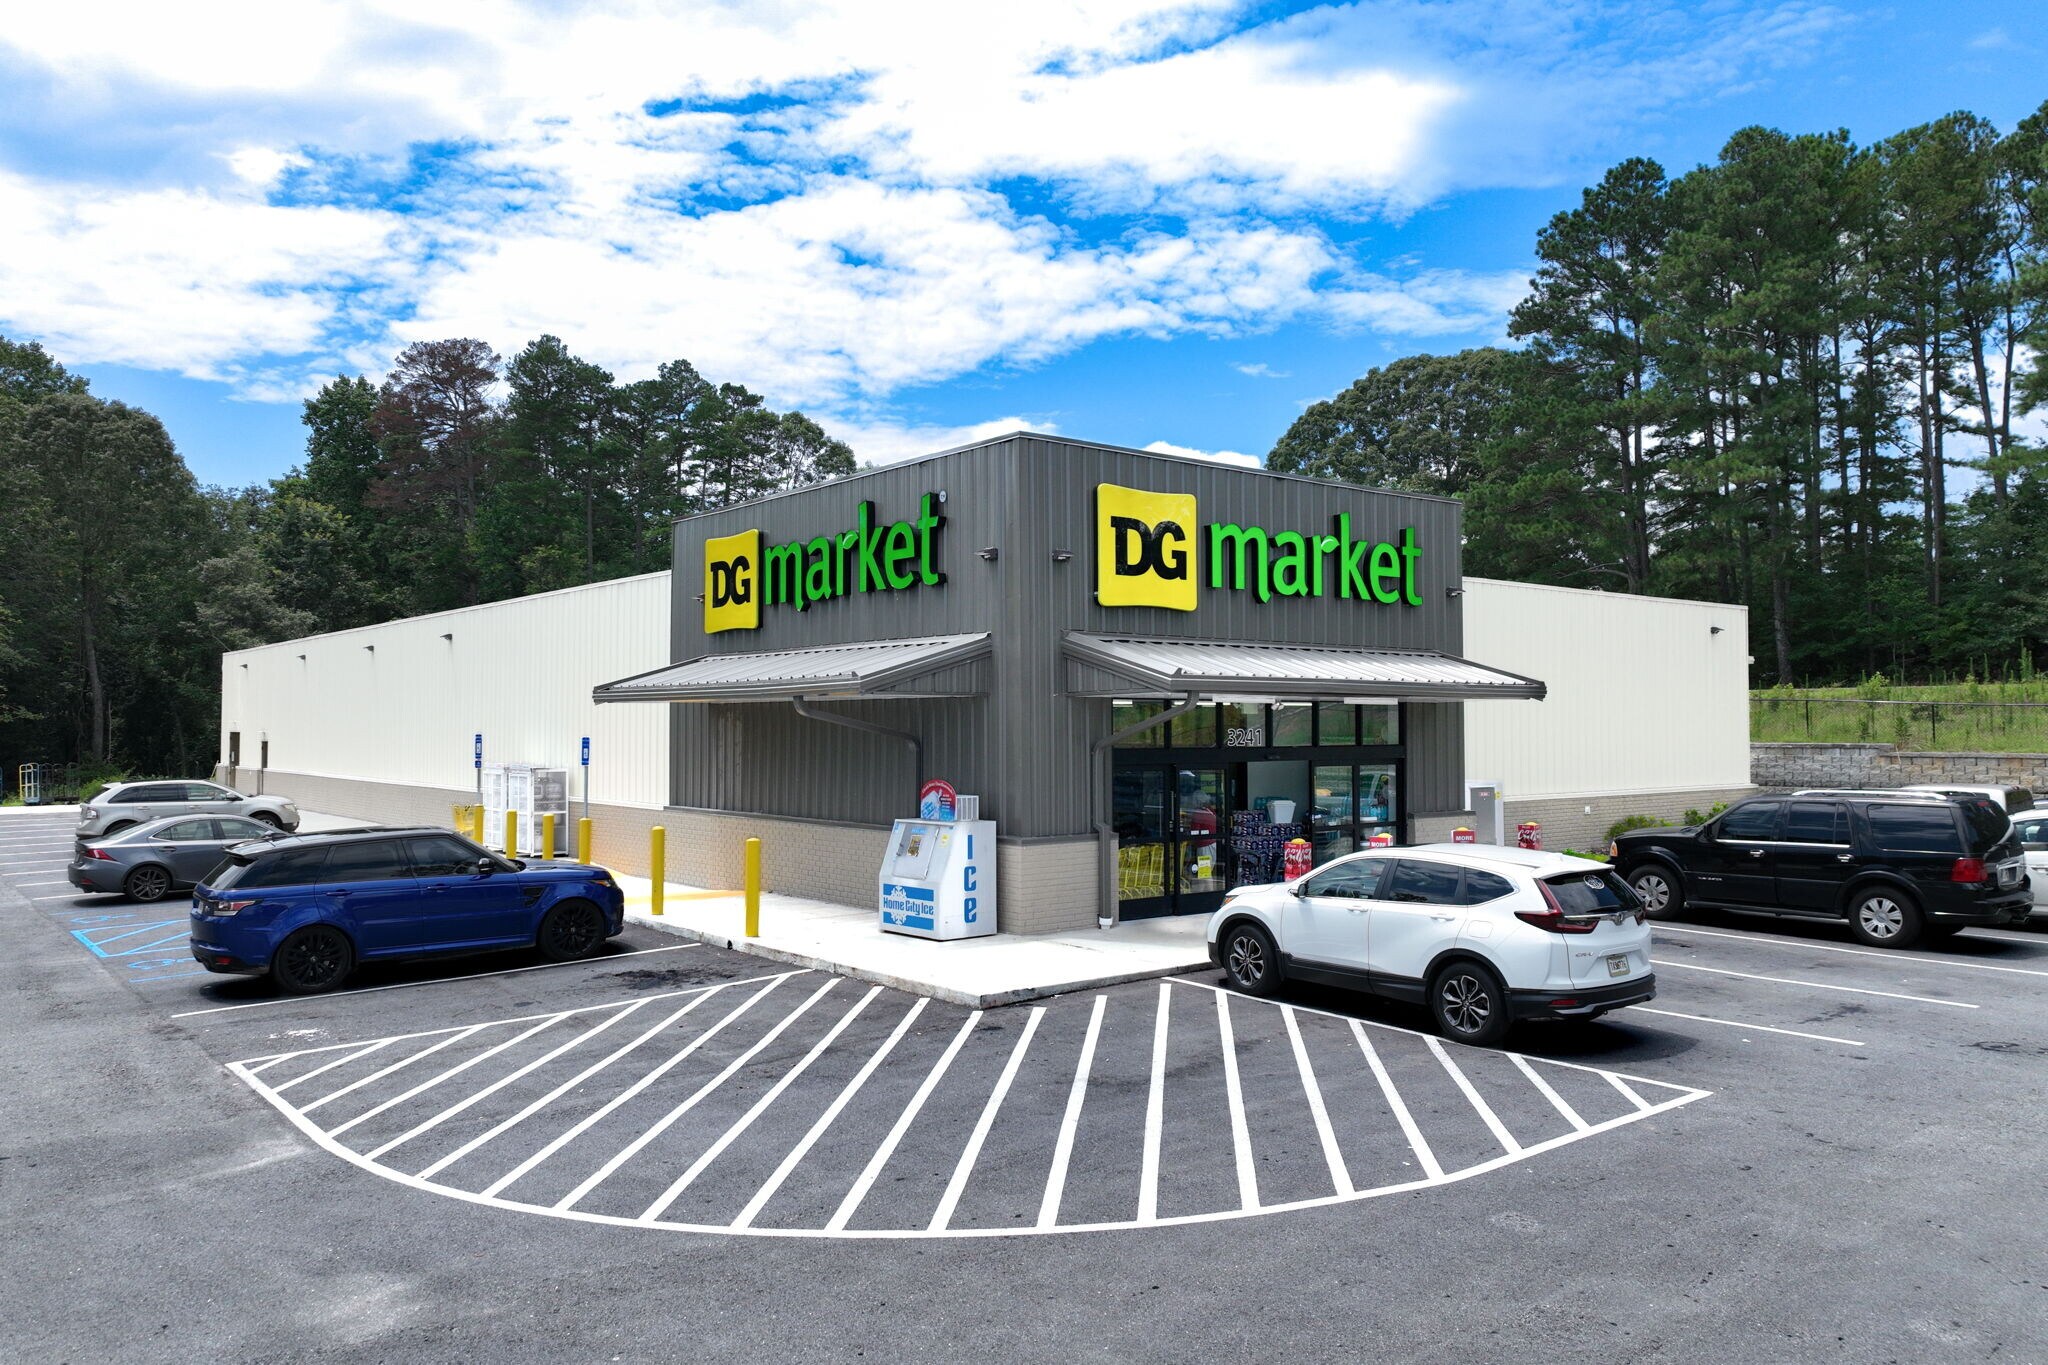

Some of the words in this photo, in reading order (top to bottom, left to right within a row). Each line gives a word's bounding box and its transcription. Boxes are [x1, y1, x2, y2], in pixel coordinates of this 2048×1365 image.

[710, 555, 751, 609] DG
[764, 491, 942, 612] market
[1110, 515, 1188, 580] DG
[1206, 512, 1423, 606] market
[1227, 728, 1262, 746] 3241
[883, 896, 905, 911] Home
[905, 899, 921, 916] City
[921, 901, 934, 915] Ice
